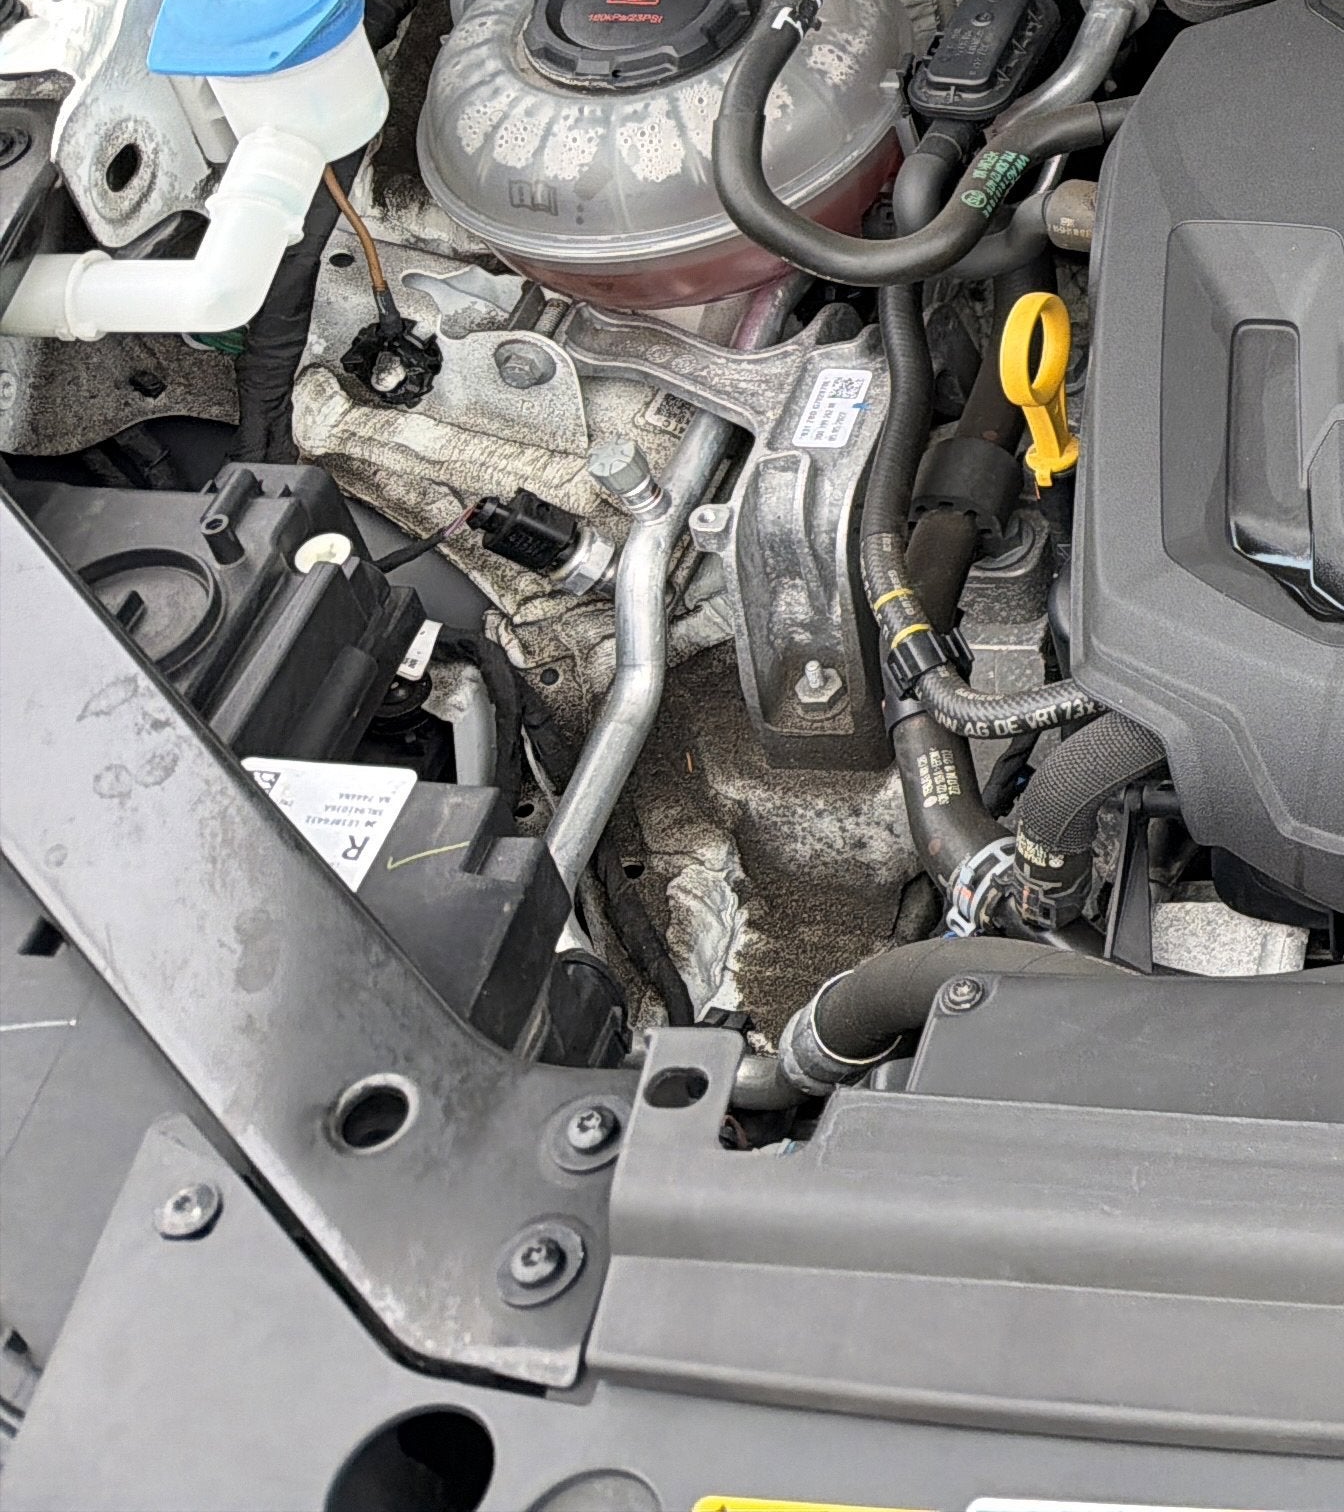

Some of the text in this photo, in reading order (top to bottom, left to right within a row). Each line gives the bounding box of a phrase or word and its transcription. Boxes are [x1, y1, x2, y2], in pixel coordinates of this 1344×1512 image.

[963, 721, 990, 737] AG
[993, 715, 1023, 735] DE
[341, 835, 370, 861] R
